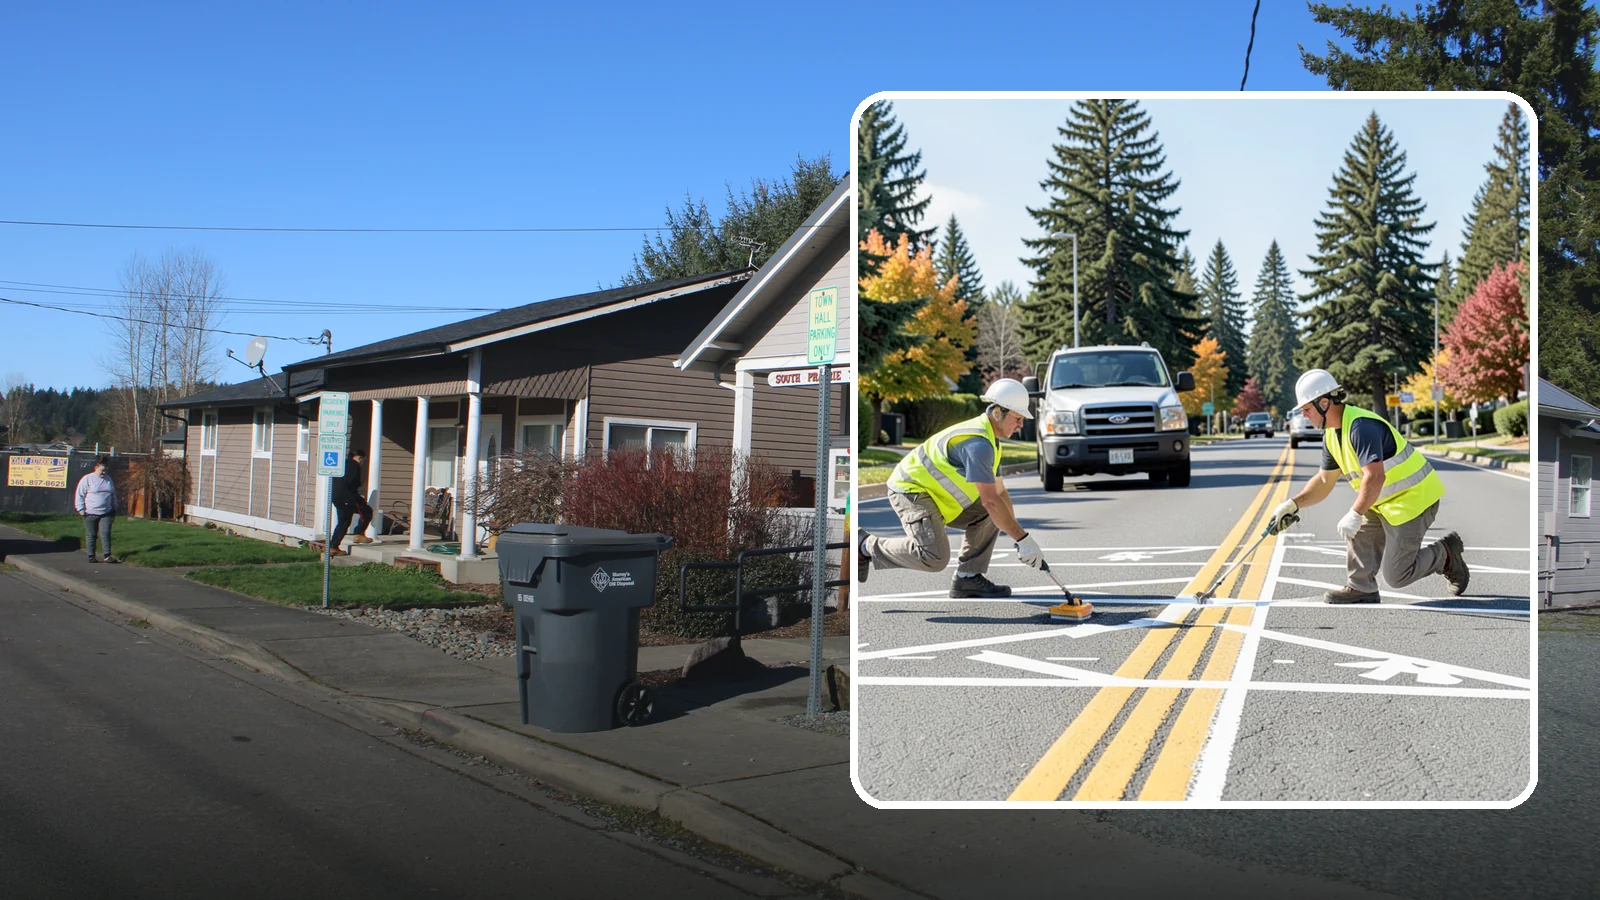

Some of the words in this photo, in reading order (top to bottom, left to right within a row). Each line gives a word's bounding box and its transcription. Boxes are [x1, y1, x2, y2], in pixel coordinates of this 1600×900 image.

[815, 295, 832, 307] TOWN
[814, 312, 831, 324] HALL
[810, 326, 835, 340] PARKING
[814, 344, 830, 357] ONLY
[775, 374, 800, 384] SOUTH
